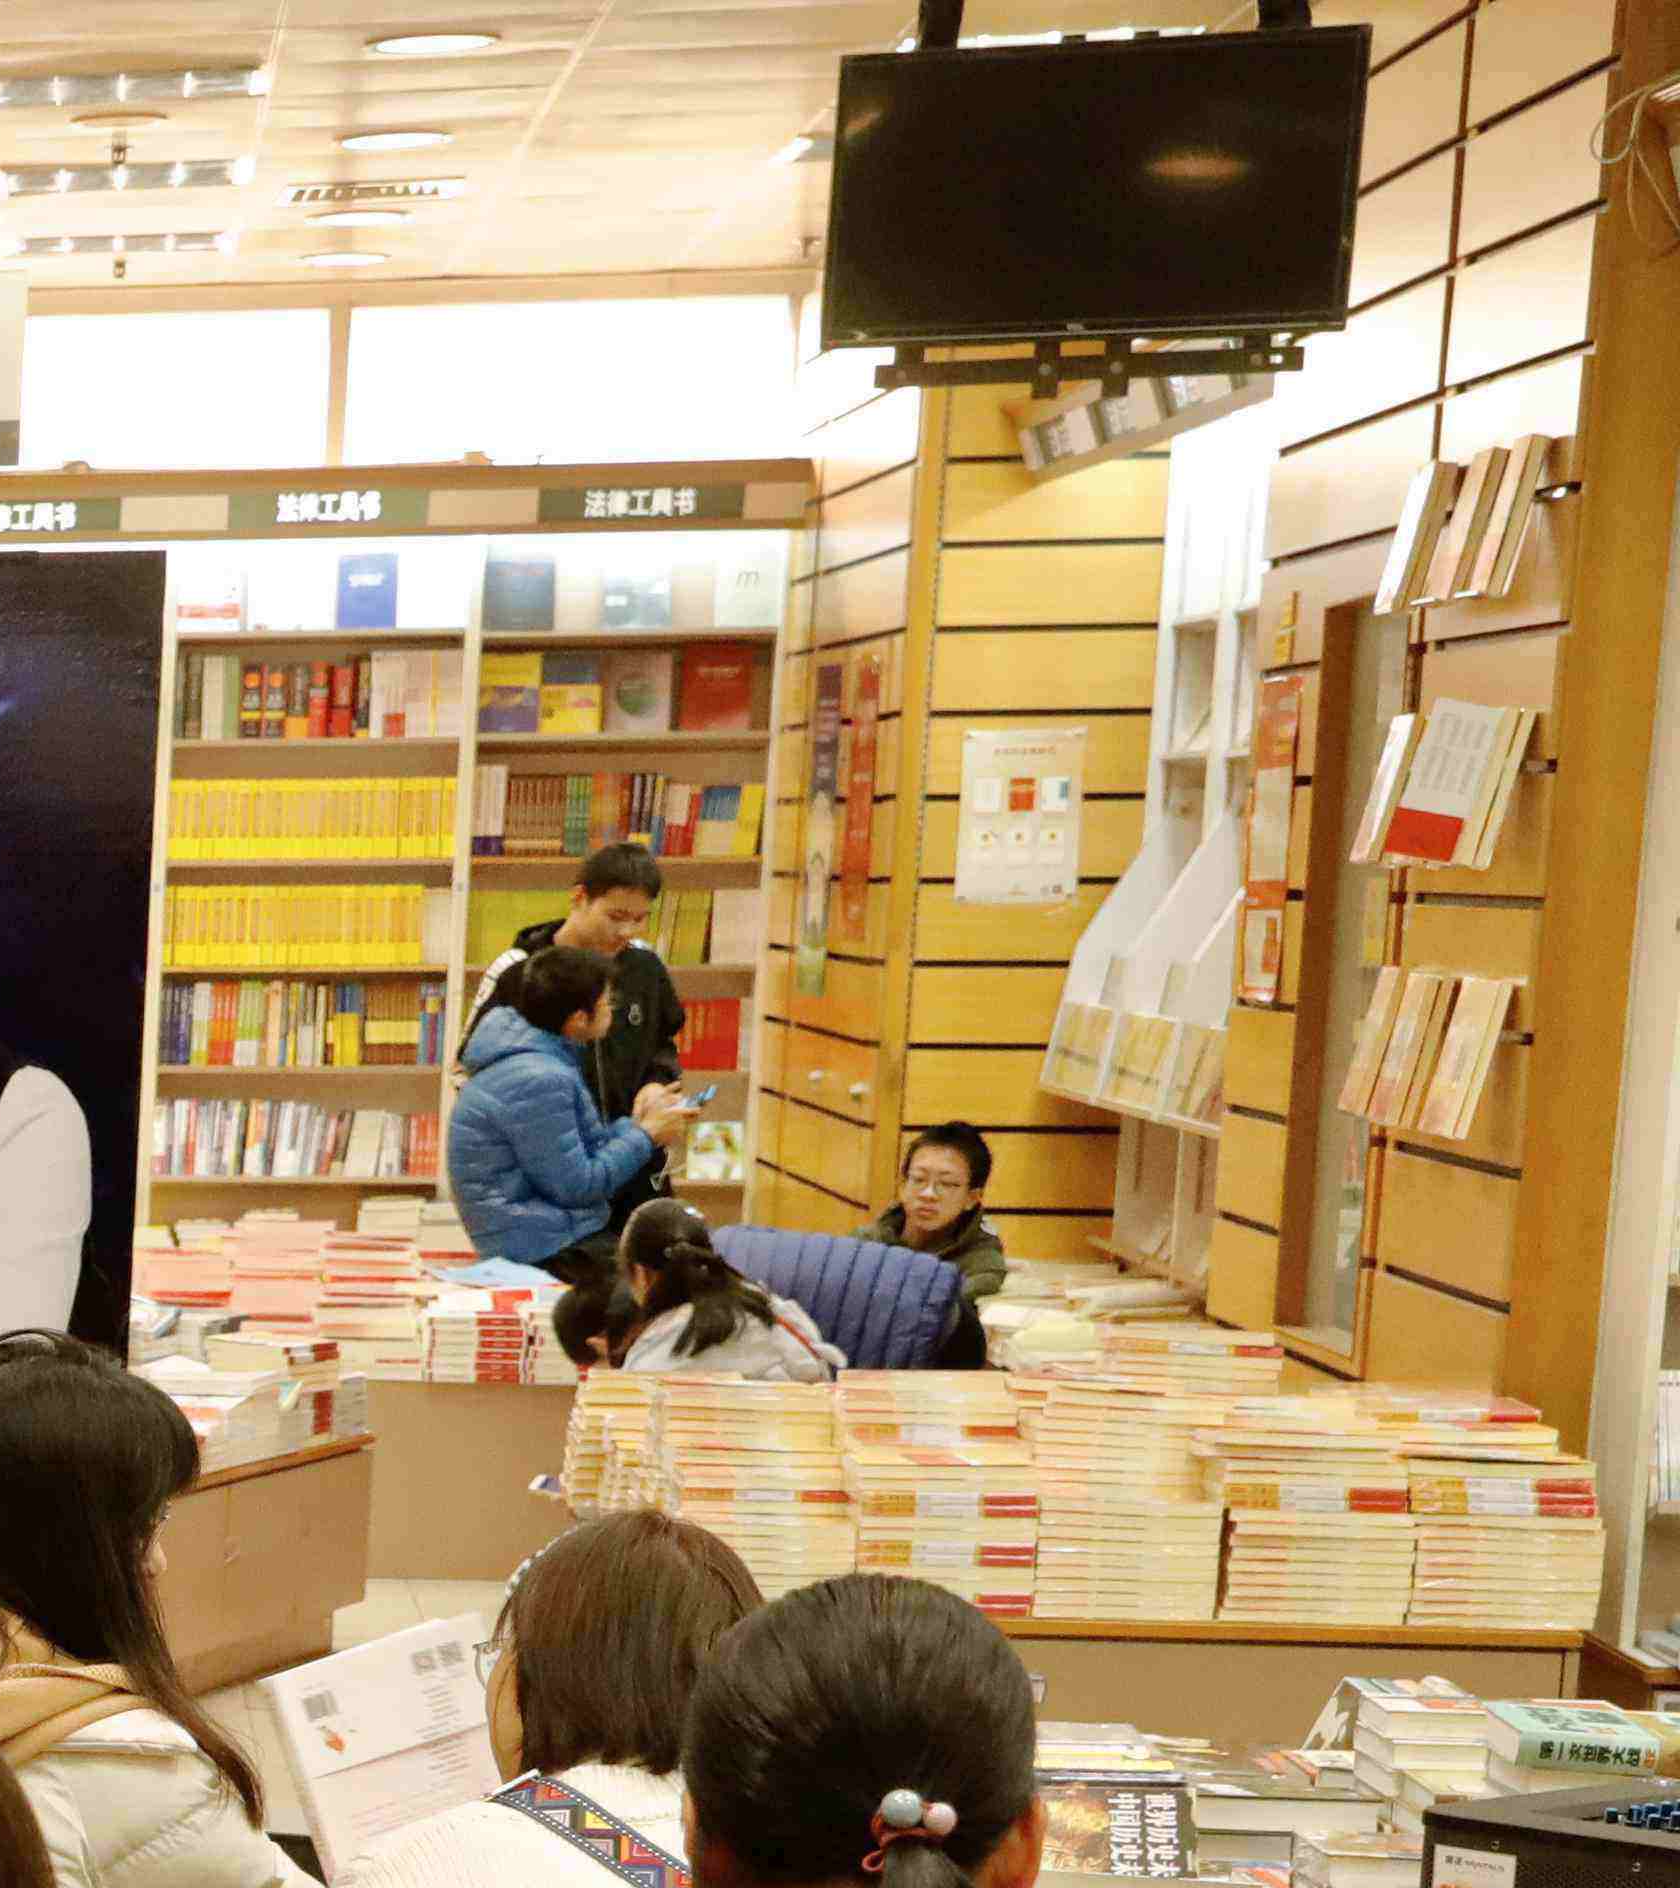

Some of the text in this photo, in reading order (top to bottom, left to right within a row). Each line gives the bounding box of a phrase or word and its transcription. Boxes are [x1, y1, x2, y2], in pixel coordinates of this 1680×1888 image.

[584, 489, 697, 518] 法律工具书
